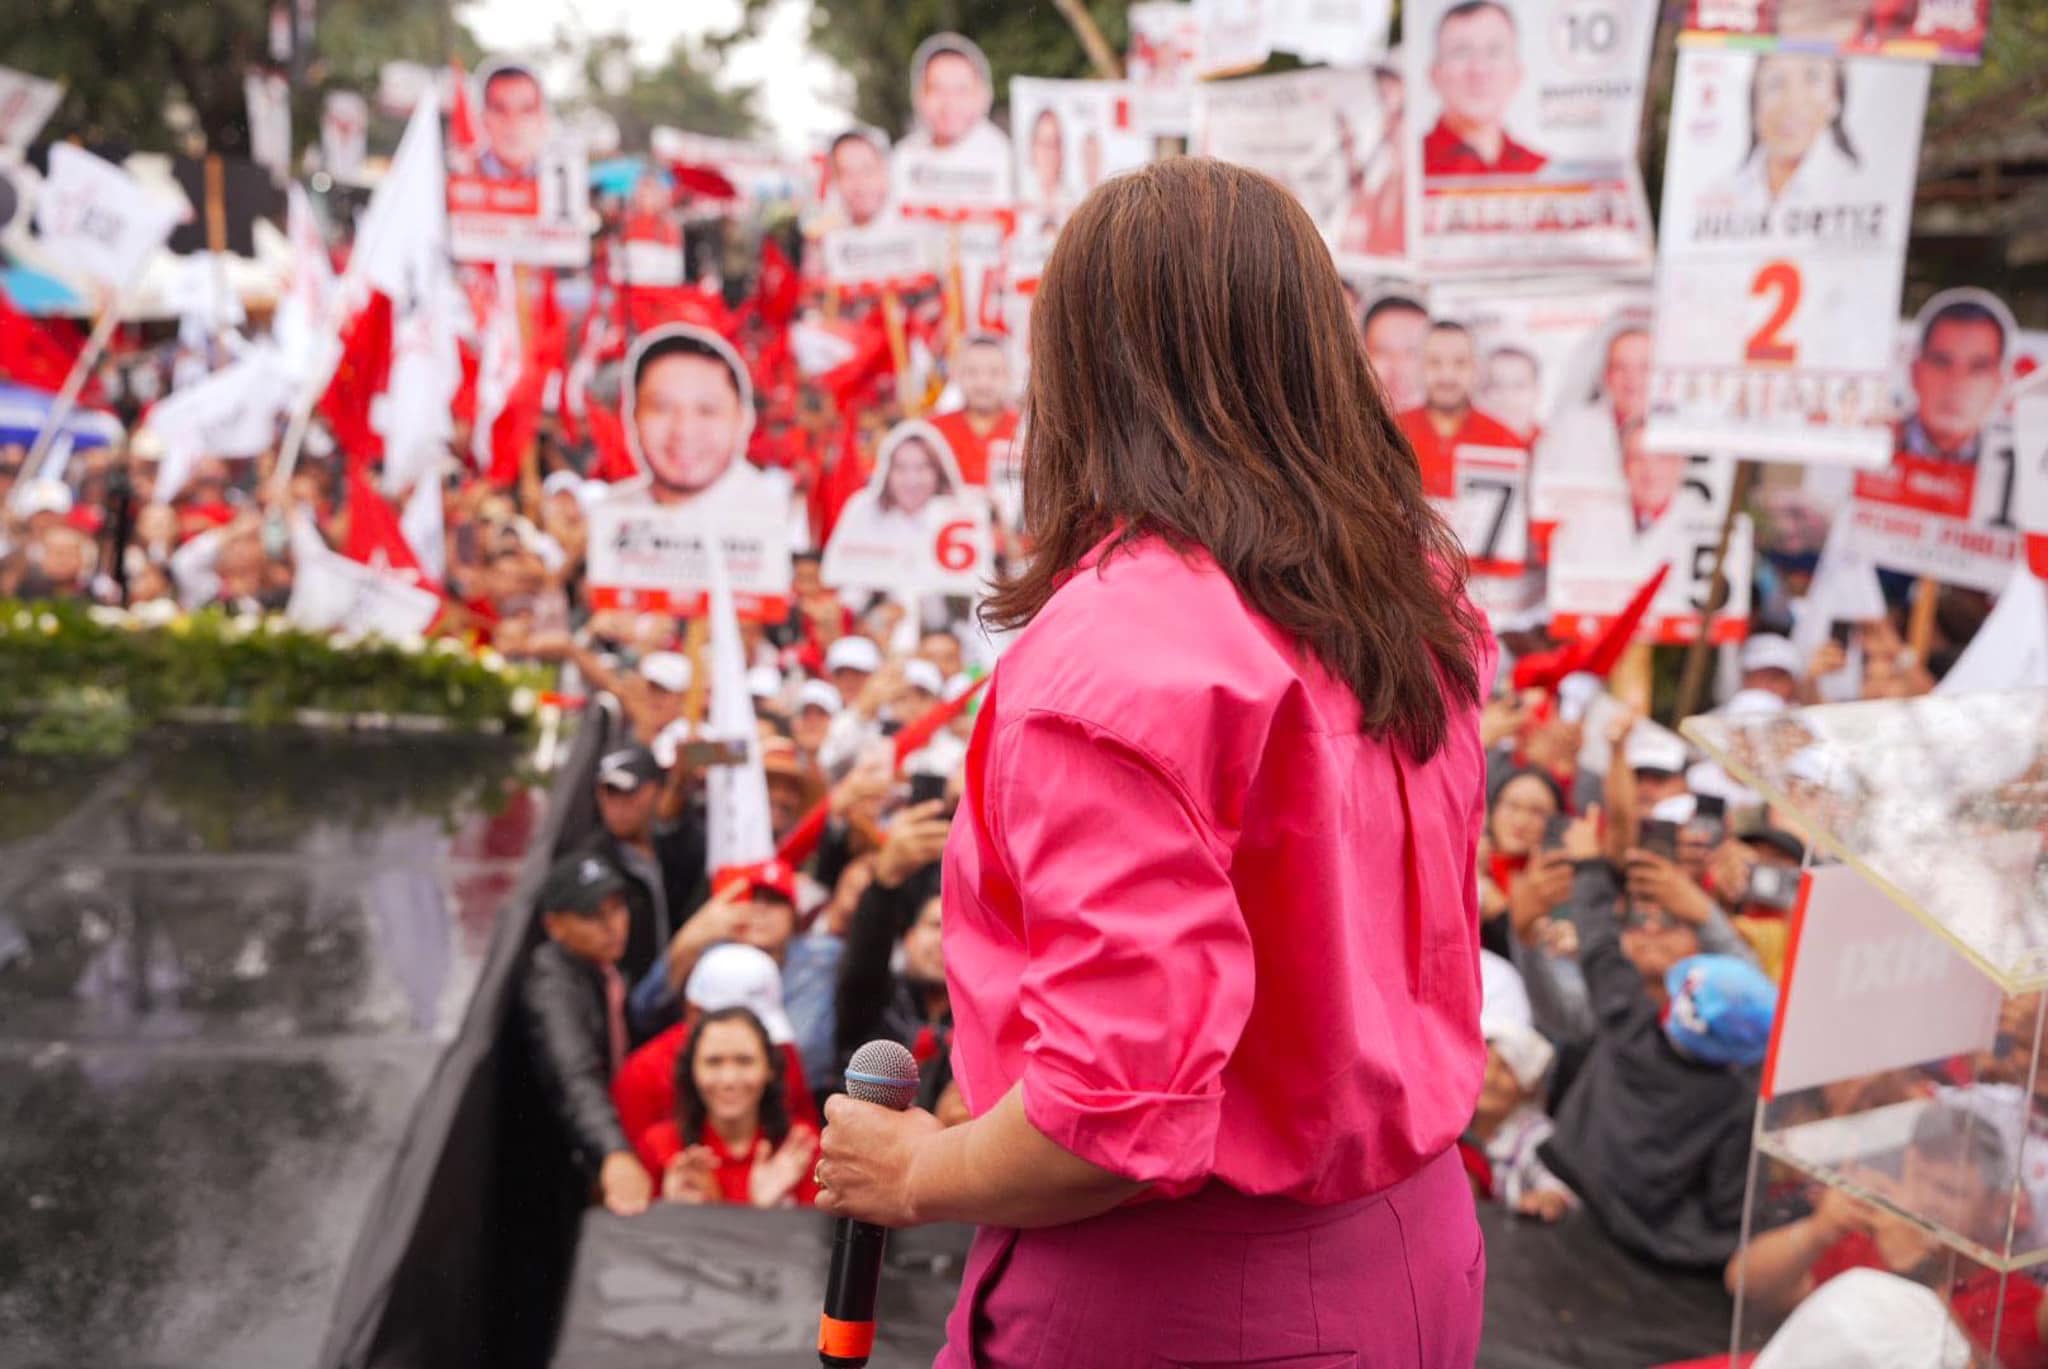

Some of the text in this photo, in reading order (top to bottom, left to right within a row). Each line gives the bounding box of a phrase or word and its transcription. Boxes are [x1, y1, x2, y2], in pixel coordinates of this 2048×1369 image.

[1564, 11, 1617, 53] 10
[1744, 260, 1801, 365] 2
[1465, 477, 1512, 561] 7
[1986, 446, 2018, 529] 1
[935, 519, 978, 575] 6
[1690, 545, 1732, 613] 5
